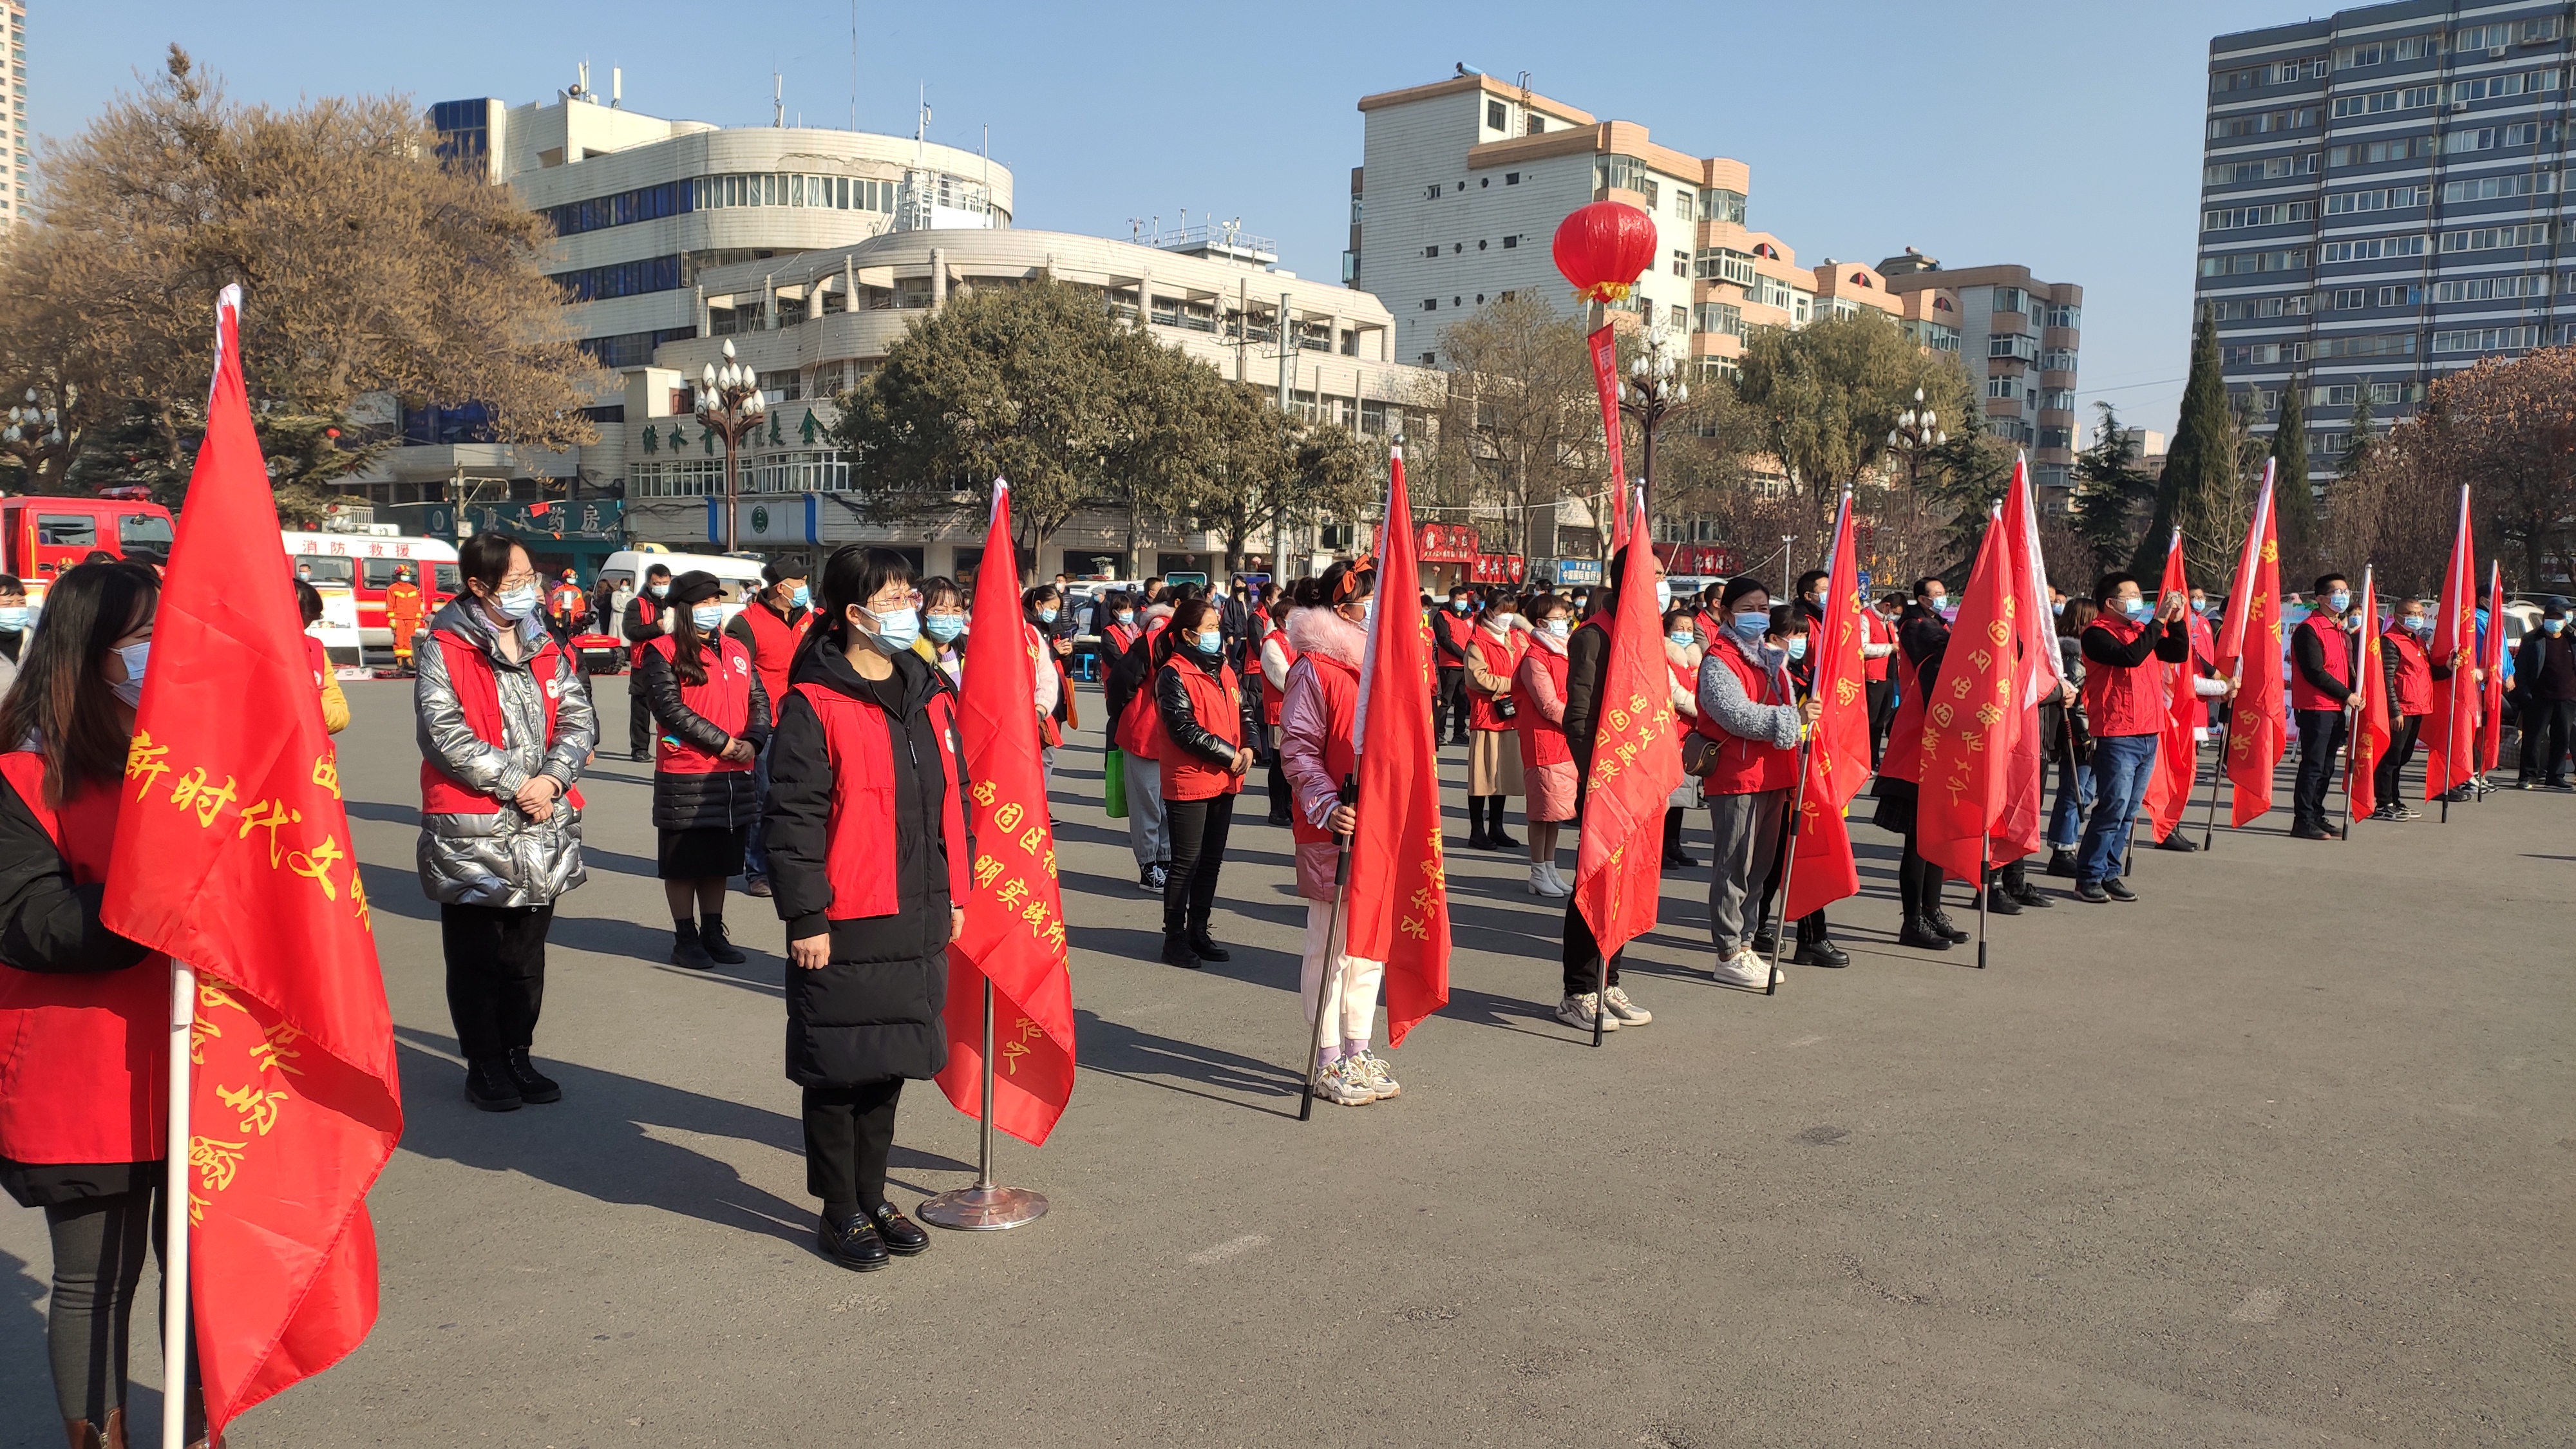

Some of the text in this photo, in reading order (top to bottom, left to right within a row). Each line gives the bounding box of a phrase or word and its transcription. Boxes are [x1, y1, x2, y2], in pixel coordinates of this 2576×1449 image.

[303, 540, 410, 558] 消防救援
[974, 854, 1070, 975] 明实践所
